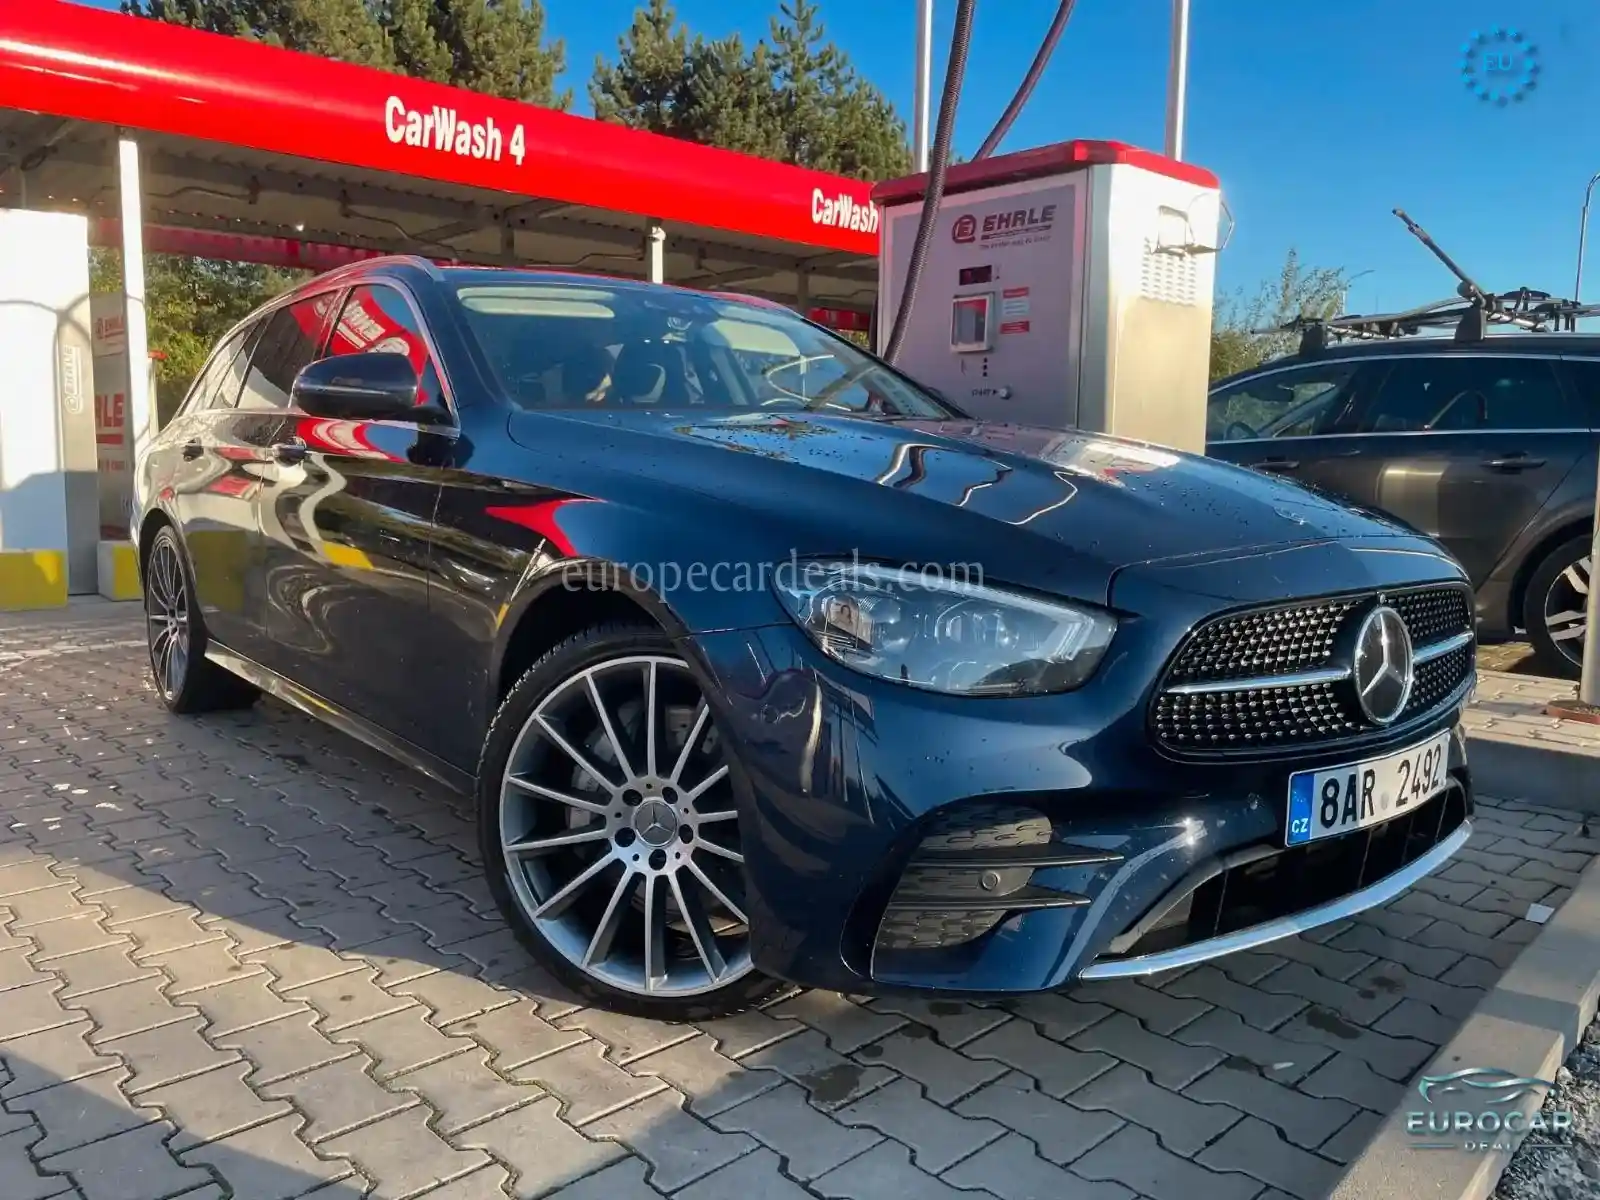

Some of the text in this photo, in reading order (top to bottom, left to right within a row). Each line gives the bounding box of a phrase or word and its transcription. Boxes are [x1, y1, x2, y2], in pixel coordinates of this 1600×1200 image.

[385, 95, 526, 166] CarWash 4
[812, 187, 878, 235] CarWash
[982, 204, 1057, 232] EHRLE
[1320, 743, 1442, 829] 8AR 2492
[1291, 817, 1309, 834] CZ
